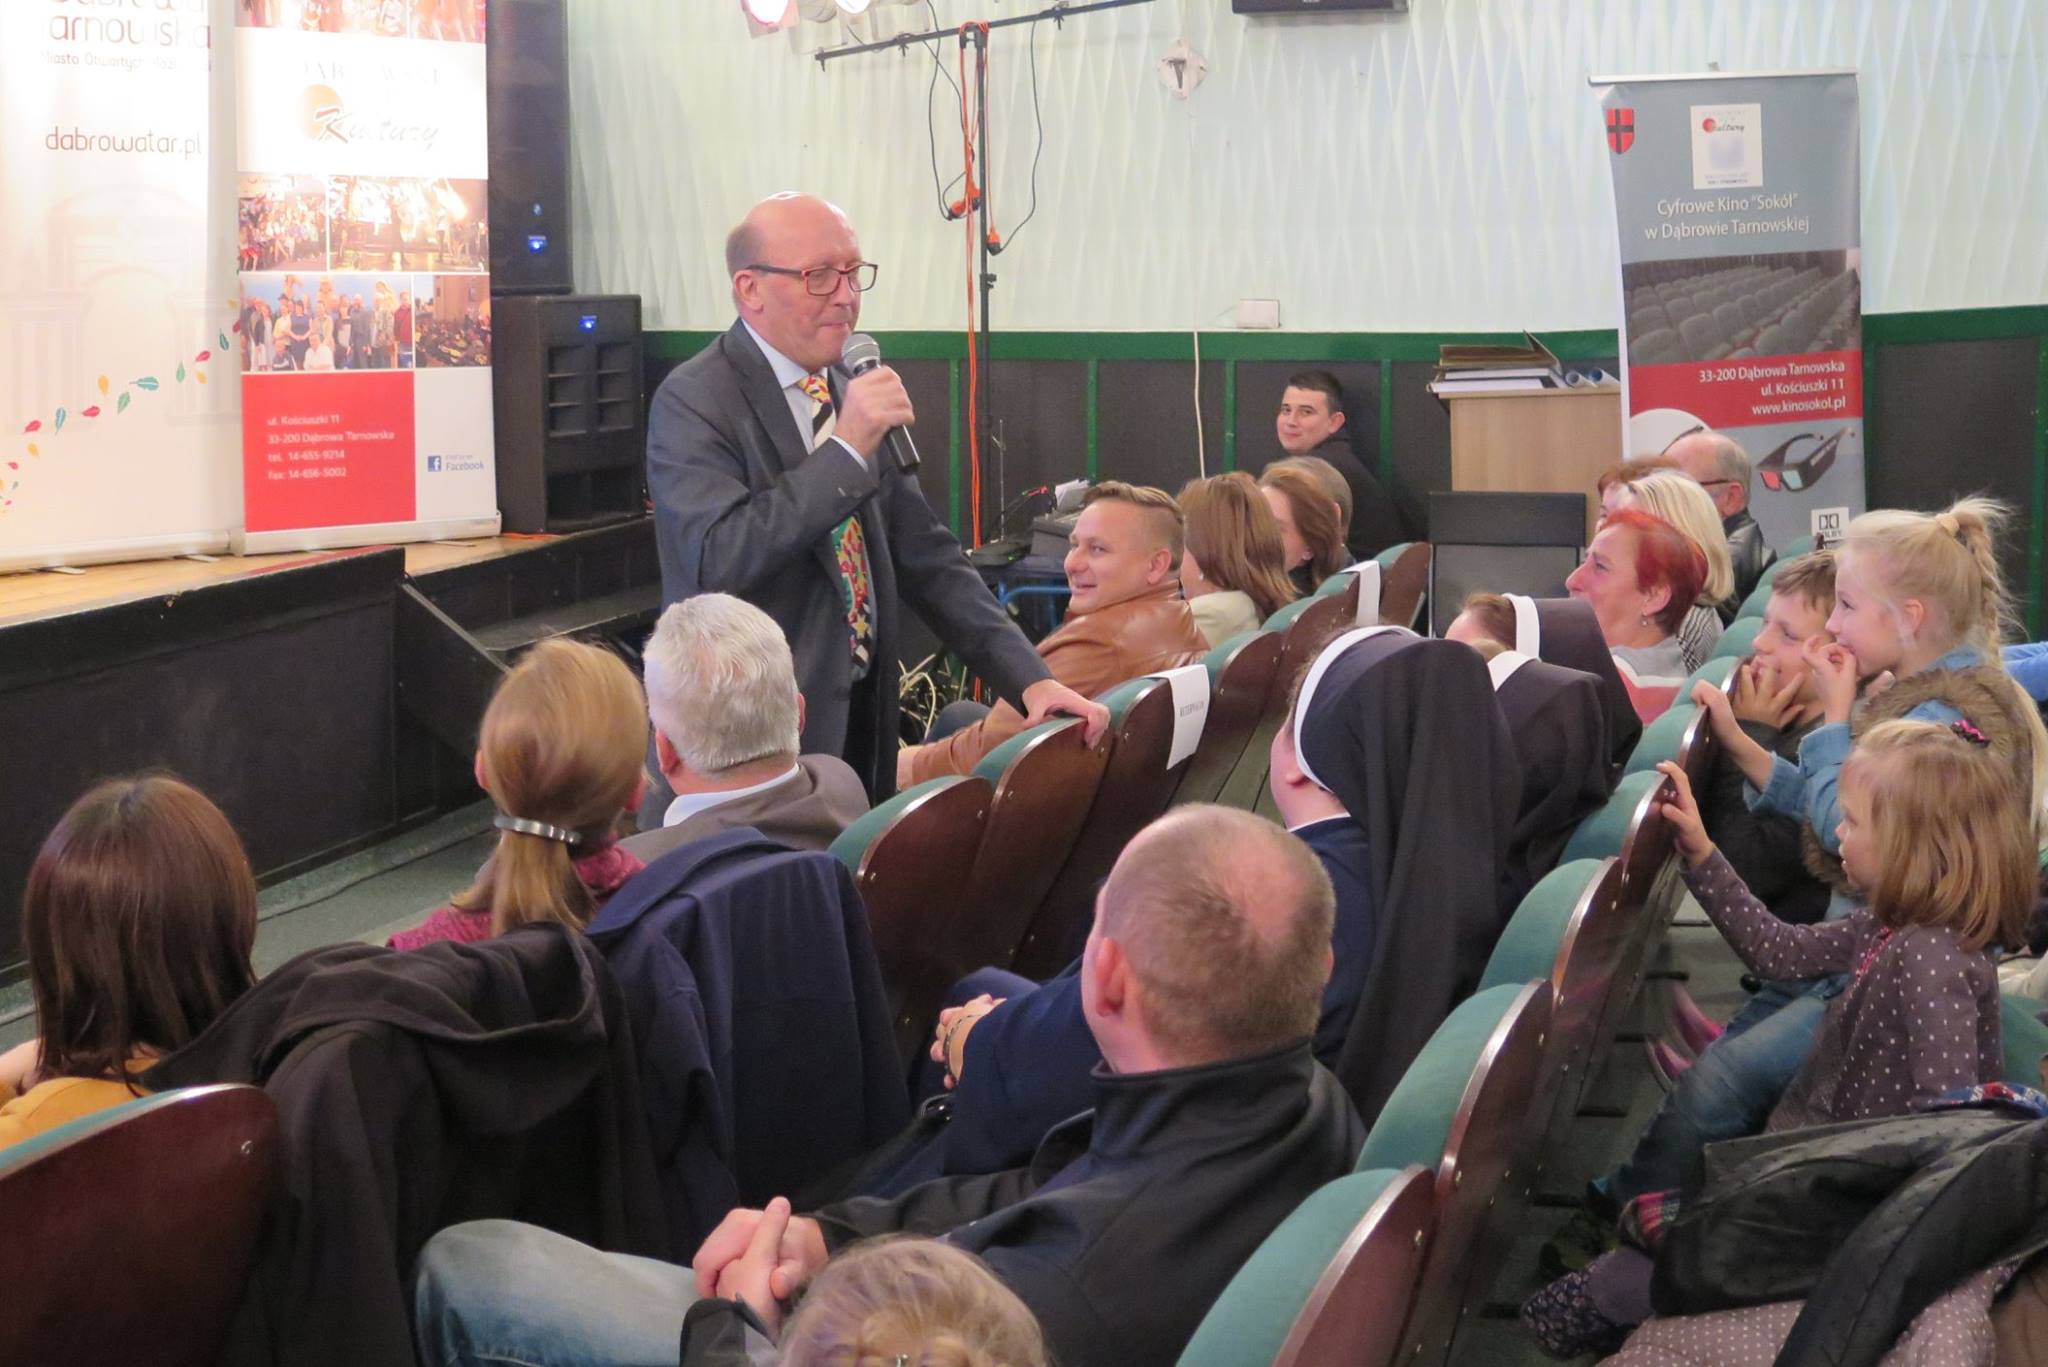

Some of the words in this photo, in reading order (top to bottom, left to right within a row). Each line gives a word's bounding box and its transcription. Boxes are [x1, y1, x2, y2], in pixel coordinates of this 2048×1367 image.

[45, 126, 202, 160] dabrowatar.pl
[1657, 199, 1714, 218] Cyfrowe
[1718, 196, 1749, 211] Kino
[1644, 228, 1658, 239] w
[1662, 221, 1729, 240] Dąbrowie
[1731, 215, 1809, 236] Tarnowskiej
[1699, 369, 1737, 383] 33-200
[1738, 365, 1787, 382] Dąbrowa
[1789, 360, 1845, 376] Tarnowska
[1761, 384, 1775, 396] ul.
[1776, 379, 1828, 395] Kościuszki
[1752, 396, 1846, 415] www.kinosokol.pl
[267, 433, 301, 445] 33-200
[345, 430, 395, 441] Tarnowska
[446, 460, 484, 472] Facebook
